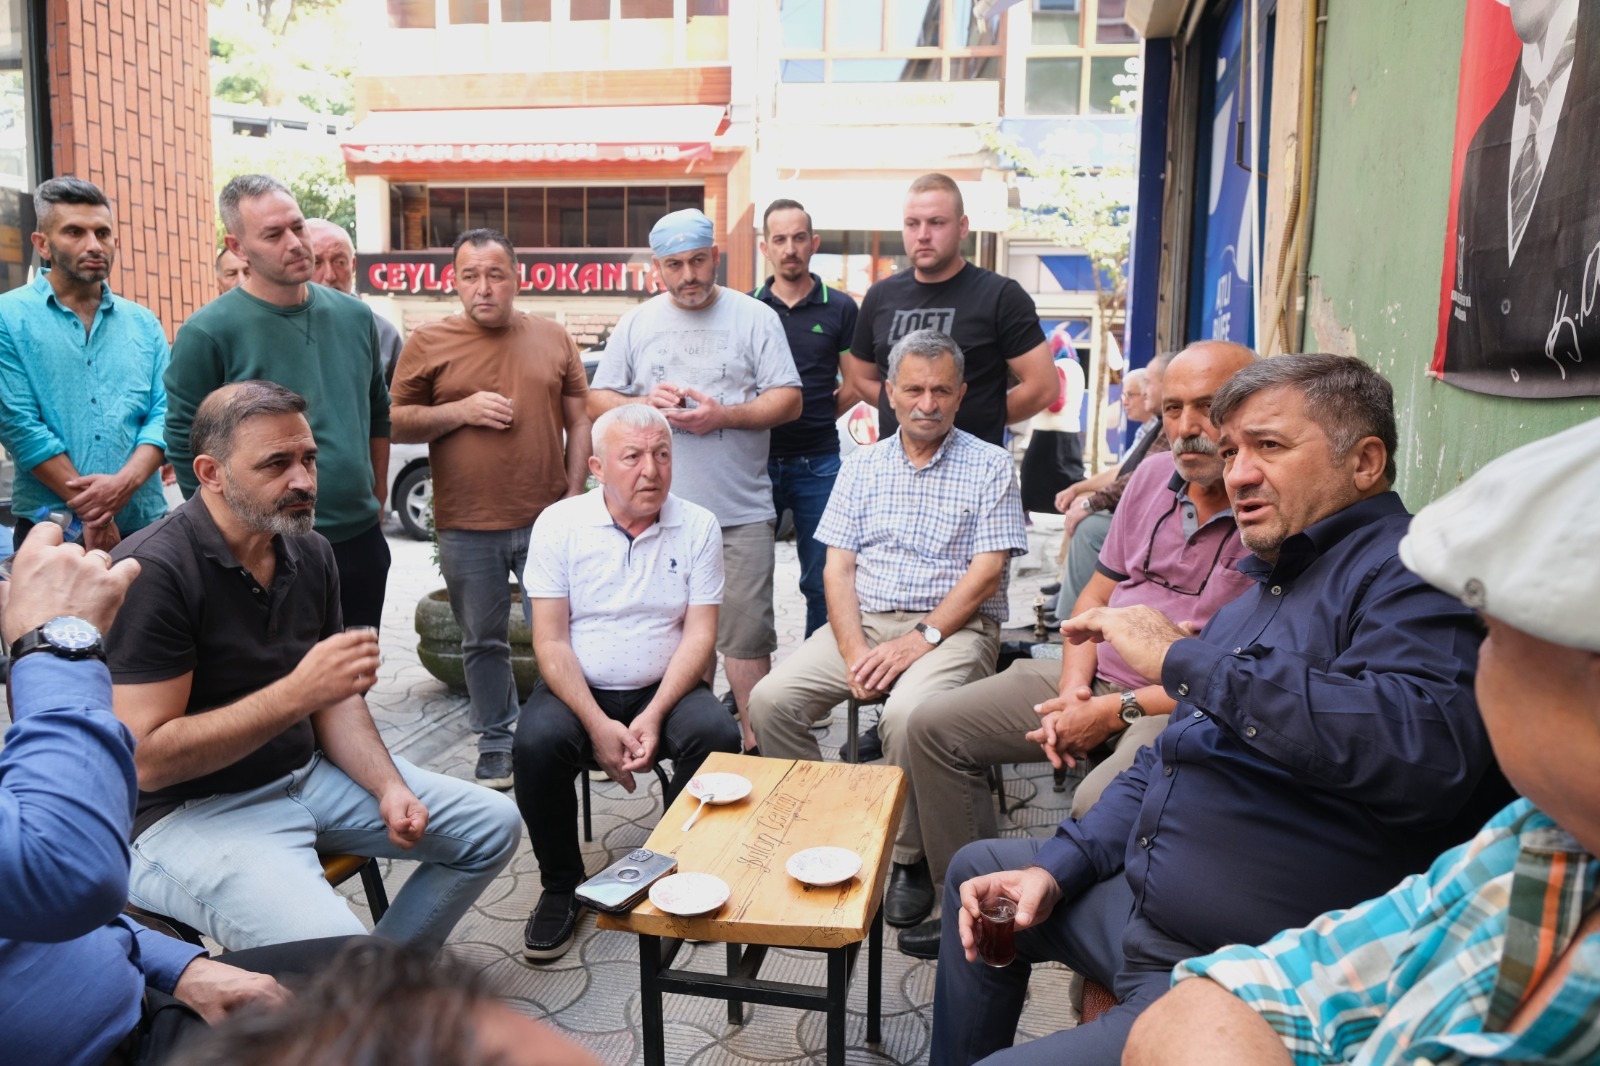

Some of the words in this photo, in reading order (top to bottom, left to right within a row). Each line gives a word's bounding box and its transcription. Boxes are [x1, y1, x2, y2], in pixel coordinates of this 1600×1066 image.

[368, 263, 457, 294] CEYLA
[518, 262, 667, 294] LOKANTA
[891, 311, 951, 341] LOFT
